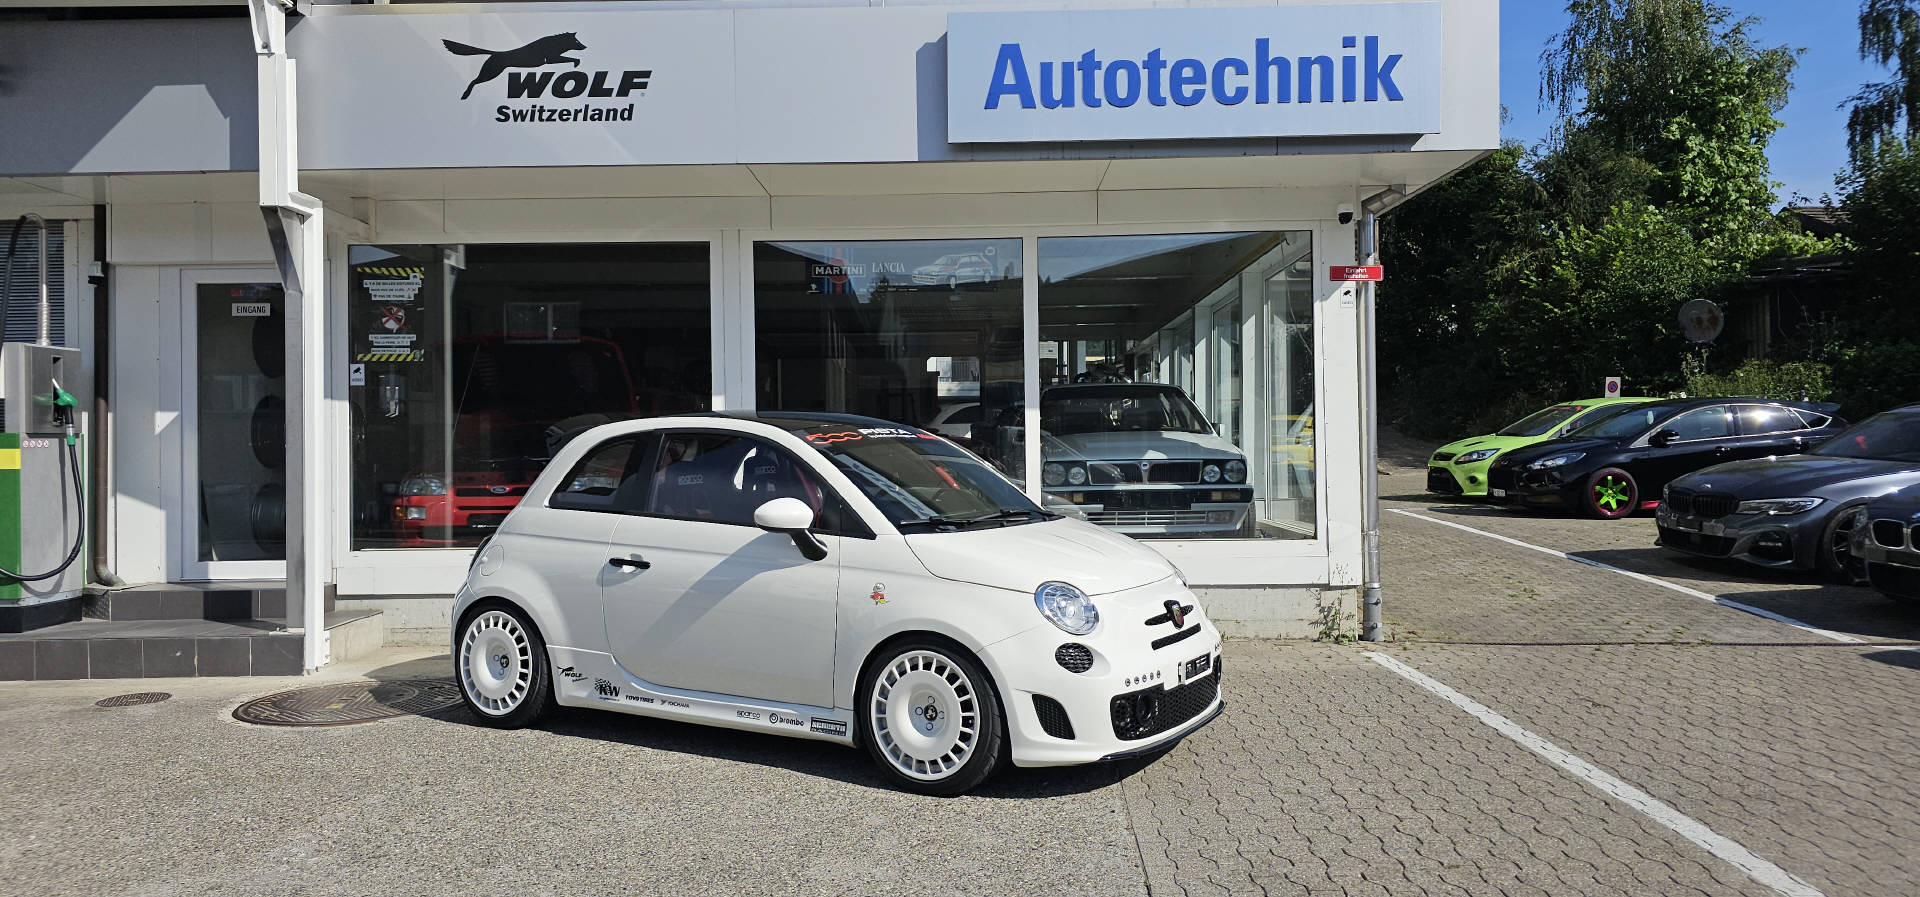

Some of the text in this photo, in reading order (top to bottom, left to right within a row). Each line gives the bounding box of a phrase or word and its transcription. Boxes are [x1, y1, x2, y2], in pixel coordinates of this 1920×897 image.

[984, 36, 1404, 109] Autotechnik
[507, 70, 652, 99] WOLF
[495, 104, 634, 123] Switzerland
[815, 266, 863, 276] MARTINI
[872, 262, 905, 273] LANCIA
[236, 305, 266, 314] EINGANG
